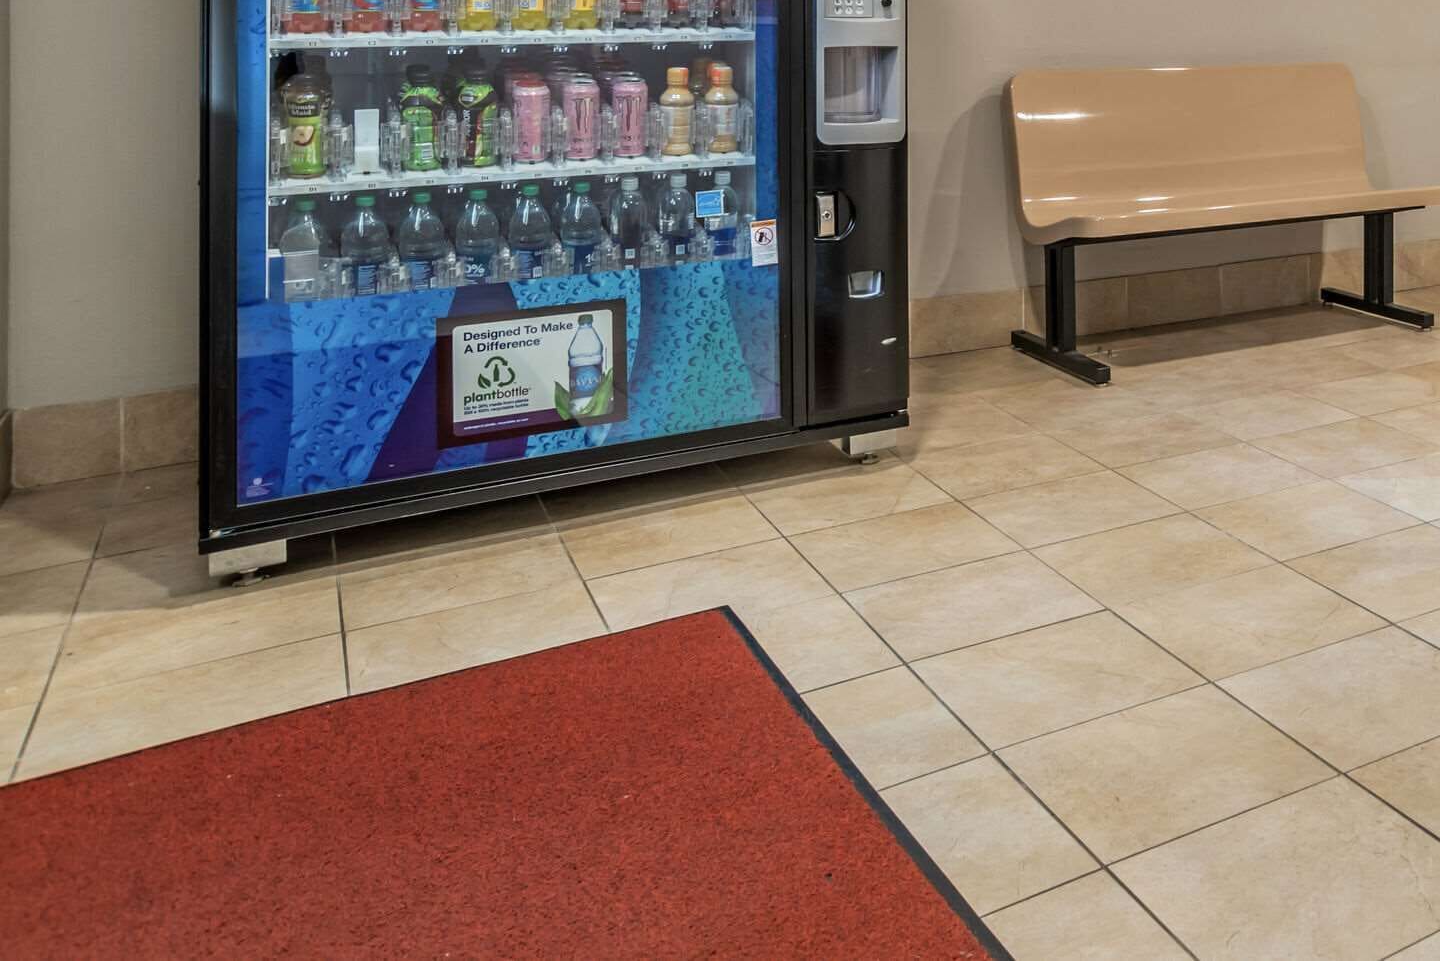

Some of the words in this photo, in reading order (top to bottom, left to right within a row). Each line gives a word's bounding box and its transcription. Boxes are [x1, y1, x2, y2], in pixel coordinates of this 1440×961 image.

[463, 327, 521, 341] Designed
[524, 325, 538, 335] To
[541, 322, 574, 332] Make
[464, 344, 474, 354] A
[477, 338, 541, 353] Difference
[463, 385, 530, 405] plantbottle
